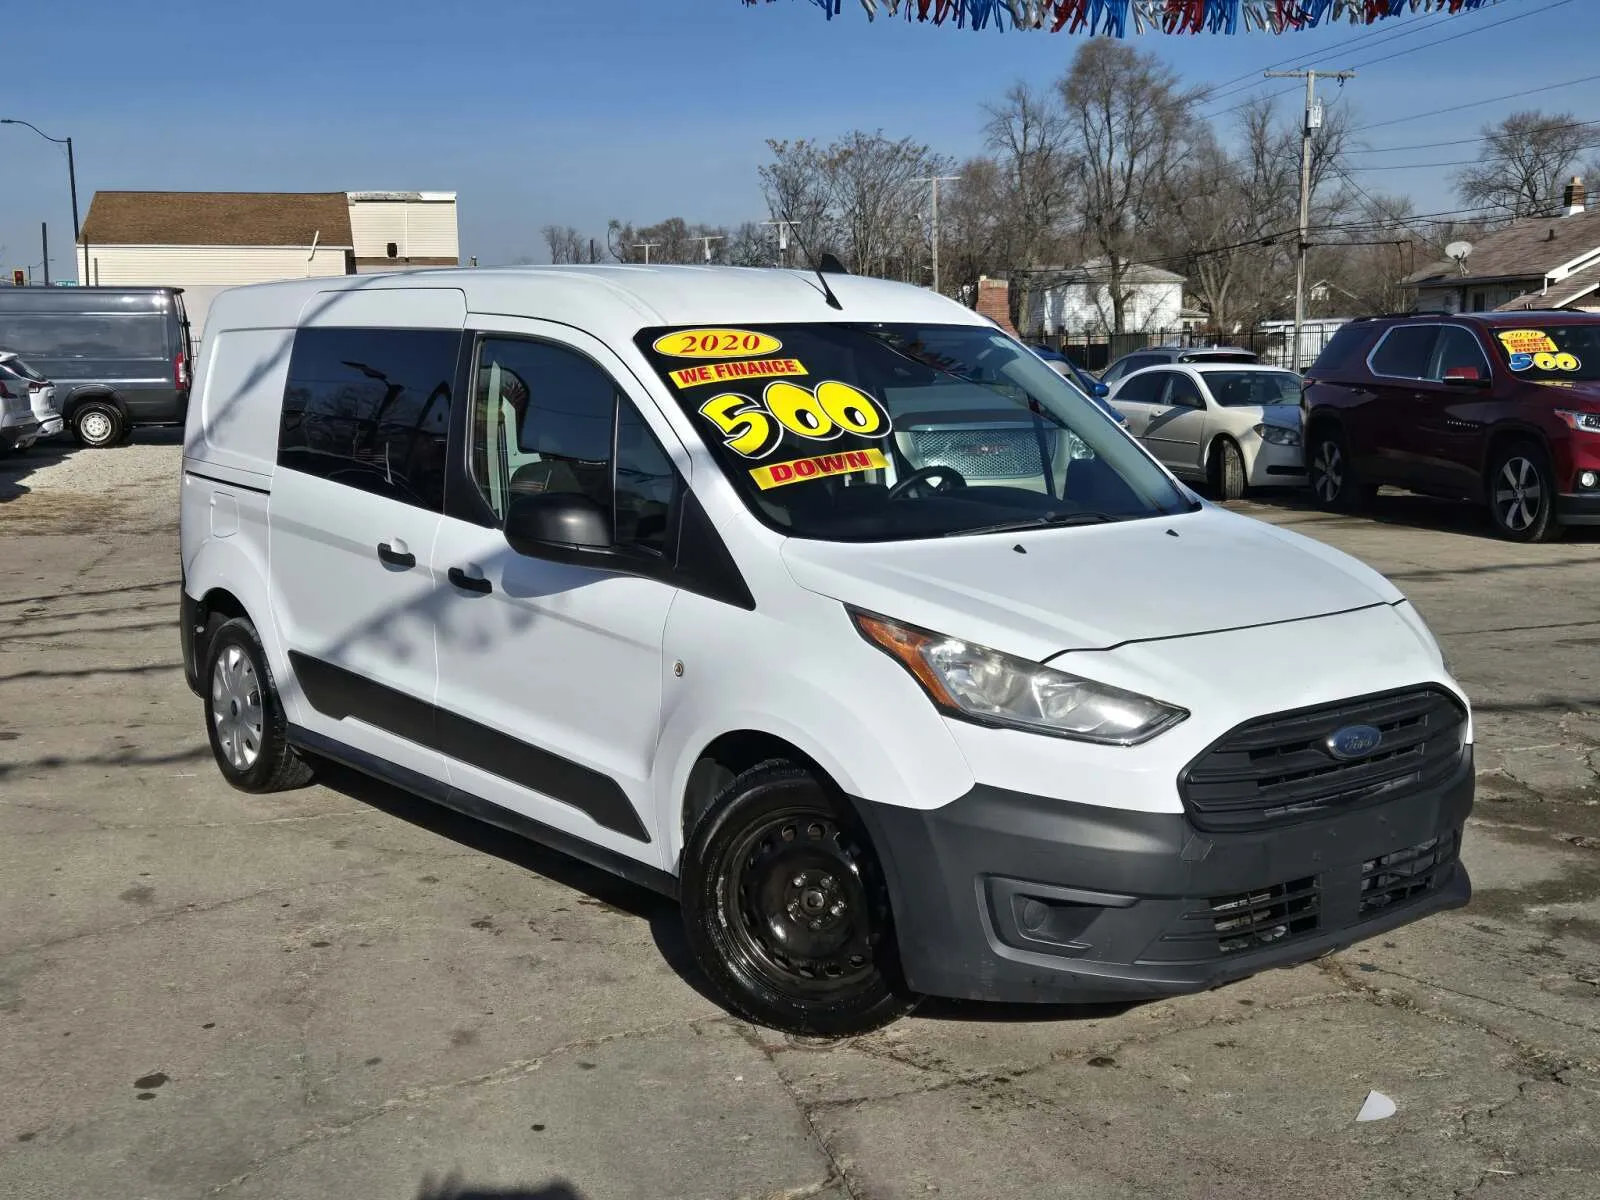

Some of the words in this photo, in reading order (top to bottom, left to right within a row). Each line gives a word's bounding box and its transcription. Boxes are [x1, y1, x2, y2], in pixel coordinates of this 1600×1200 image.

[679, 334, 761, 354] 2020
[677, 367, 711, 384] WE
[716, 360, 798, 379] FINANCE
[1509, 352, 1581, 371] 500
[698, 380, 892, 459] 500
[769, 451, 873, 483] DOWN
